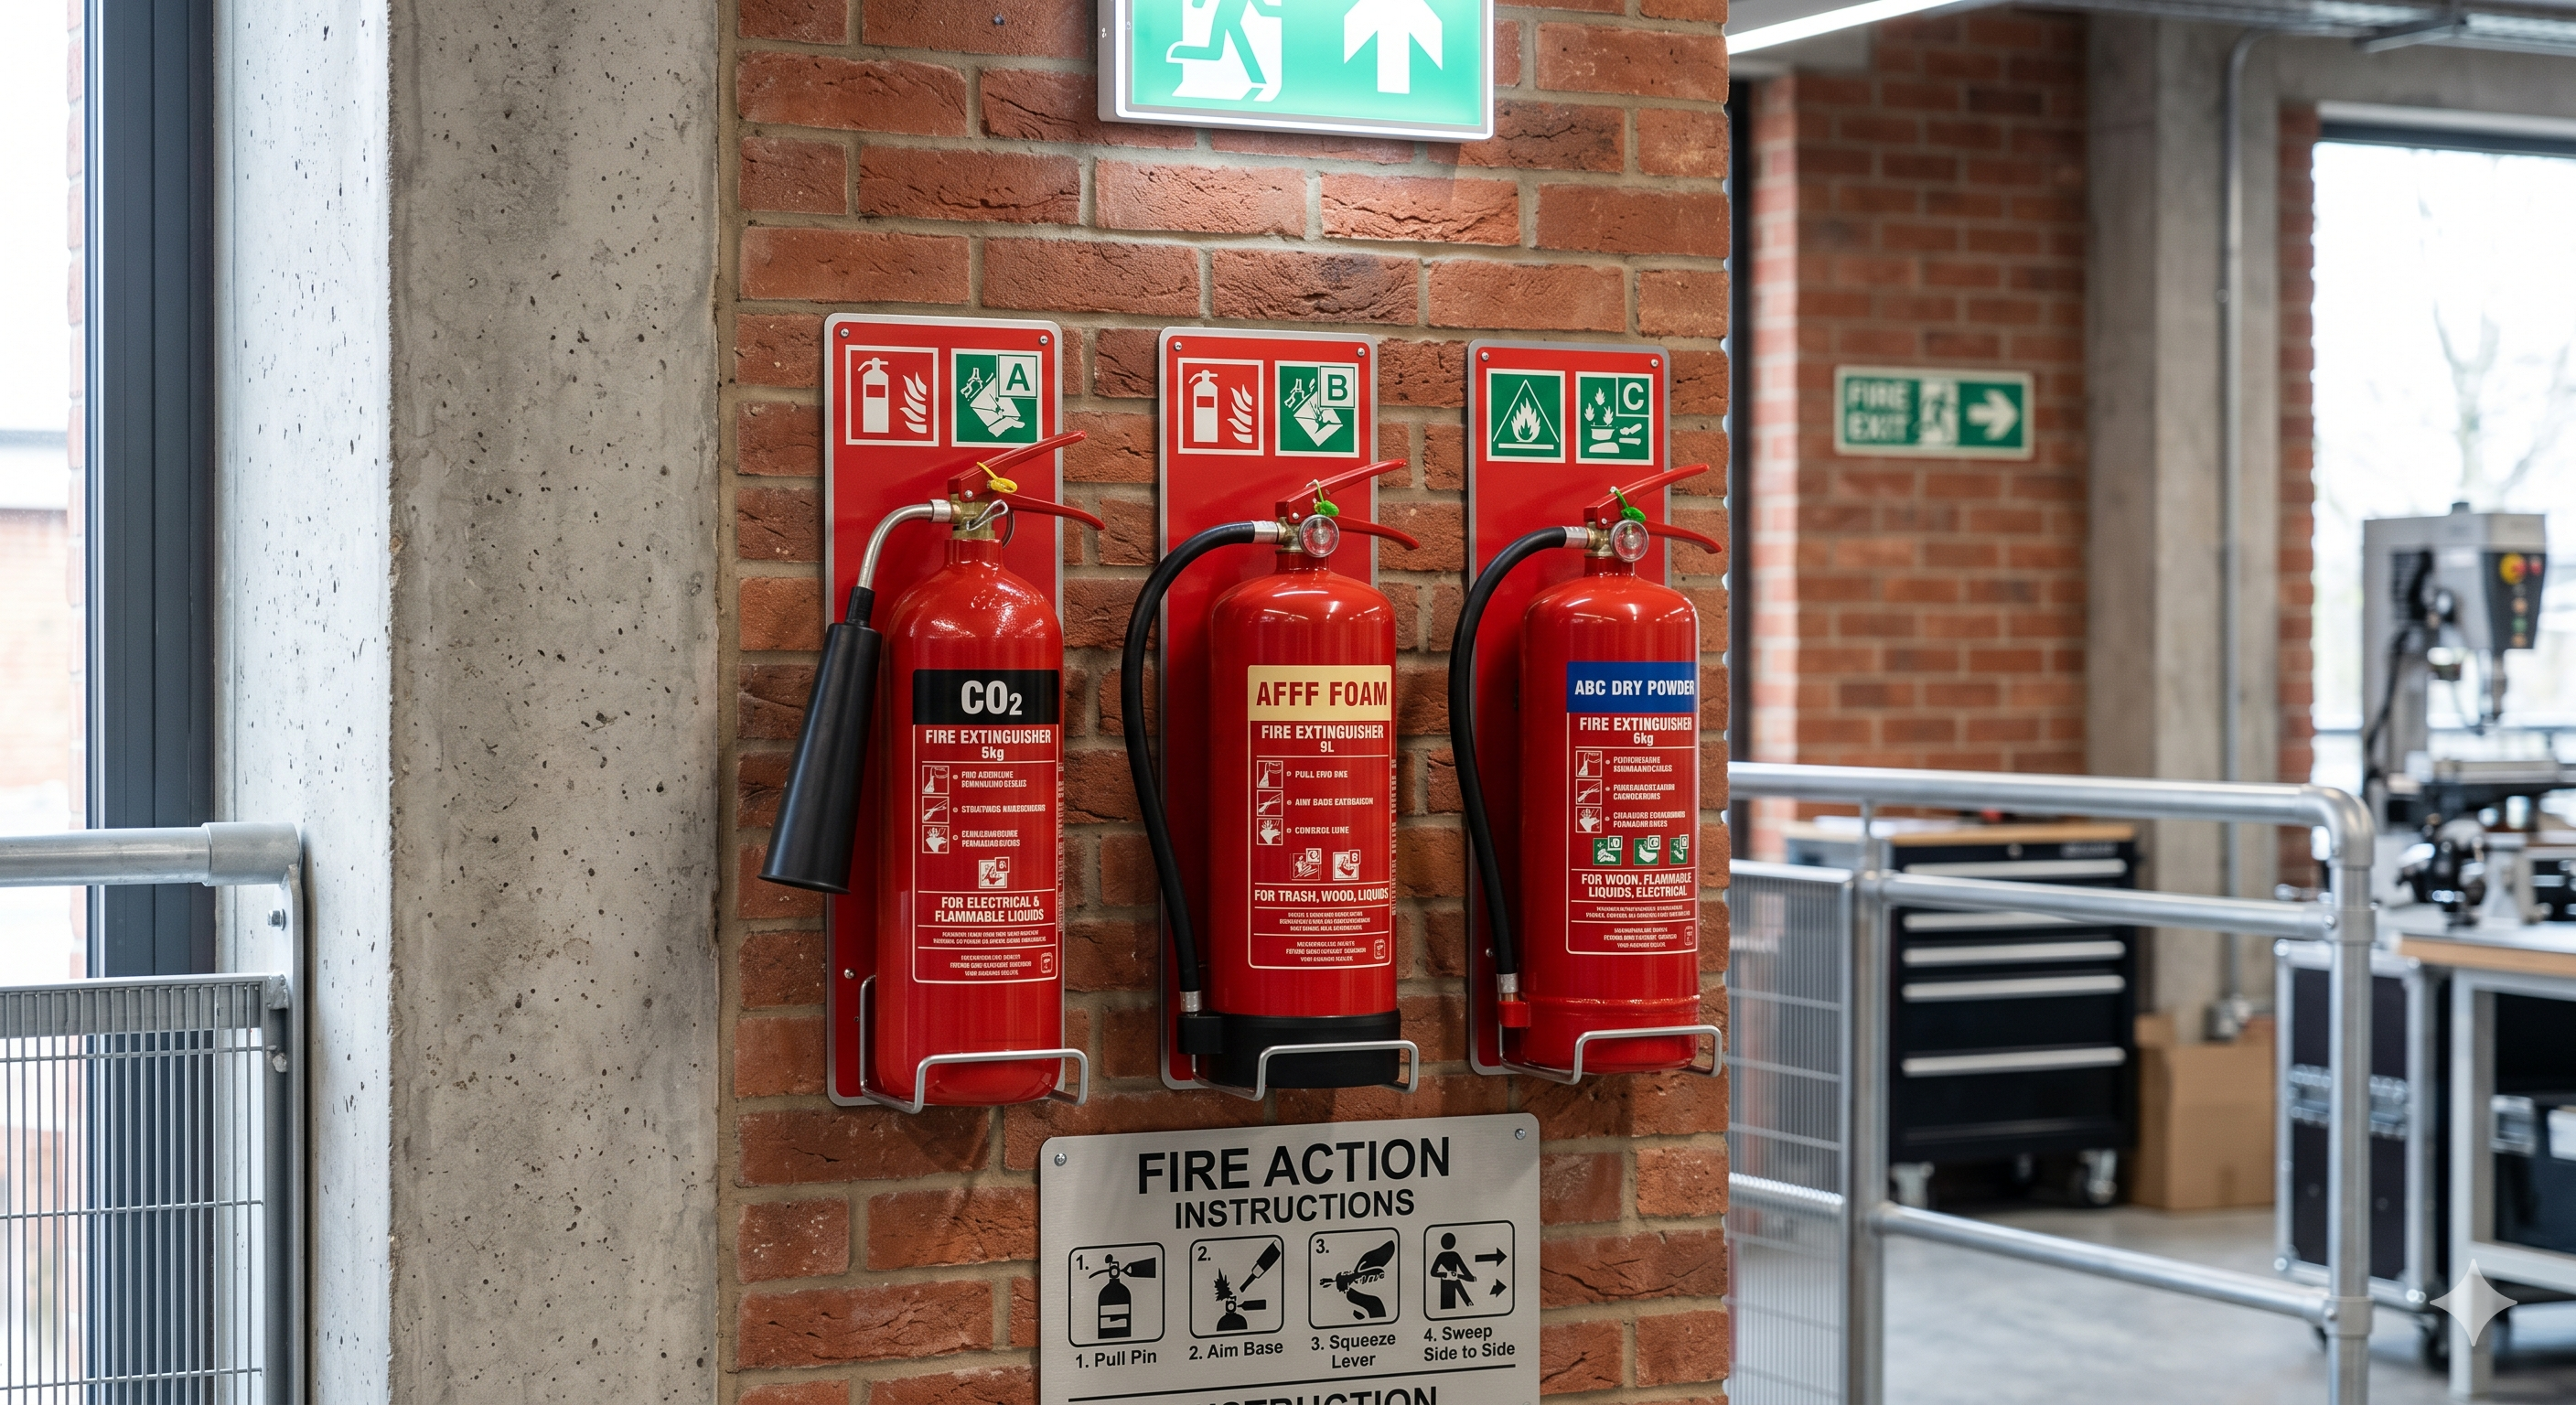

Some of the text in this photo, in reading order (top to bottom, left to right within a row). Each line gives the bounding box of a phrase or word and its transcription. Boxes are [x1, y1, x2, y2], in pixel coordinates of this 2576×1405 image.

[1006, 363, 1030, 391] A
[1328, 374, 1347, 401] B
[1623, 382, 1644, 410] C
[1847, 381, 1908, 411] FIRE
[1847, 413, 1907, 442] EXIT
[1256, 681, 1387, 707] AFFF FOAM
[1574, 680, 1694, 695] ABC DRY POWDER
[1261, 724, 1384, 739] FIRE EXTINGUISHER
[1580, 717, 1692, 731] FIRE EXTINGUISHER
[925, 729, 1051, 744] FIRE EXTINGUISHER
[1633, 733, 1654, 746] 6kg
[982, 746, 1004, 761] 5kg
[1320, 741, 1334, 753] 9L
[1294, 770, 1315, 778] PULL
[1581, 874, 1602, 885] FOR
[1644, 872, 1692, 885] FLAMMABLE
[1254, 887, 1389, 903] FOR TRASH, WOOD, LIQUIDS
[1588, 885, 1687, 899] LIQUIDS, ELECTRICAL
[941, 896, 1040, 908] FOR ELECTRICAL &
[935, 908, 1044, 923] FLAMMABLE LIQUIDS
[1139, 1136, 1449, 1195] FIRE ACTION
[1175, 1188, 1415, 1229] INSTRUCTIONS
[1197, 1246, 1211, 1261] 2.
[1315, 1238, 1329, 1254] 3.
[1076, 1254, 1089, 1271] 1.
[1423, 1326, 1492, 1343] 4. Sweep
[1188, 1341, 1283, 1360] 2. Aim Base
[1311, 1334, 1396, 1352] 3. Squeeze
[1075, 1349, 1157, 1368] 1. Pull Pin
[1423, 1341, 1516, 1362] Side to Side
[1332, 1353, 1376, 1368] Lever
